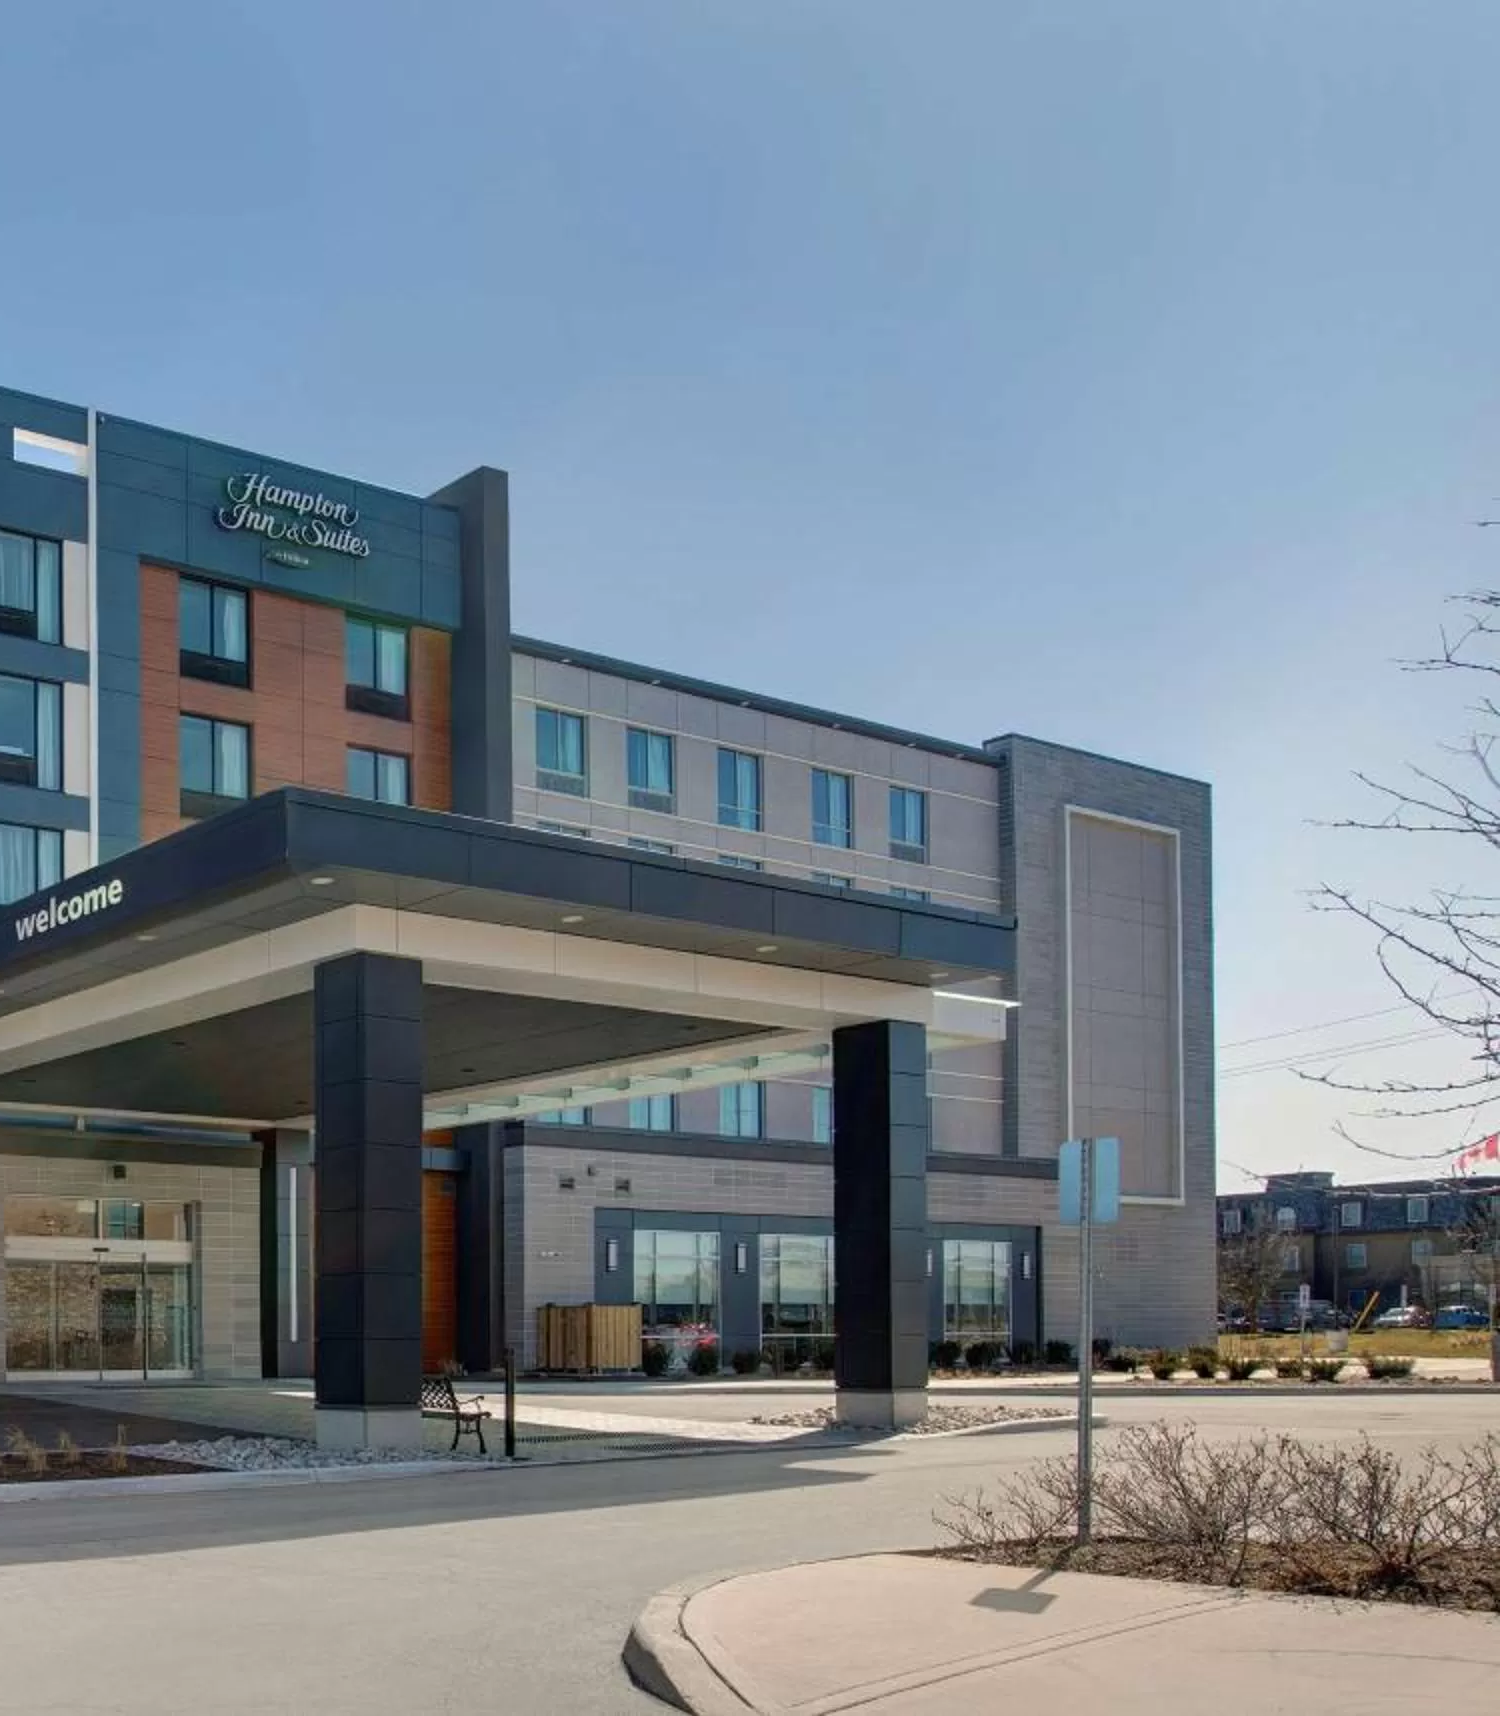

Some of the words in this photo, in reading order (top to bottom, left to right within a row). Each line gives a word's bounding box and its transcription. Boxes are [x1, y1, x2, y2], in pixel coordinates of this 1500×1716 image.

[227, 473, 359, 527] Hampton
[219, 503, 286, 539] Inn
[286, 523, 303, 545] &
[302, 519, 371, 557] Suites
[15, 879, 123, 941] welcome
